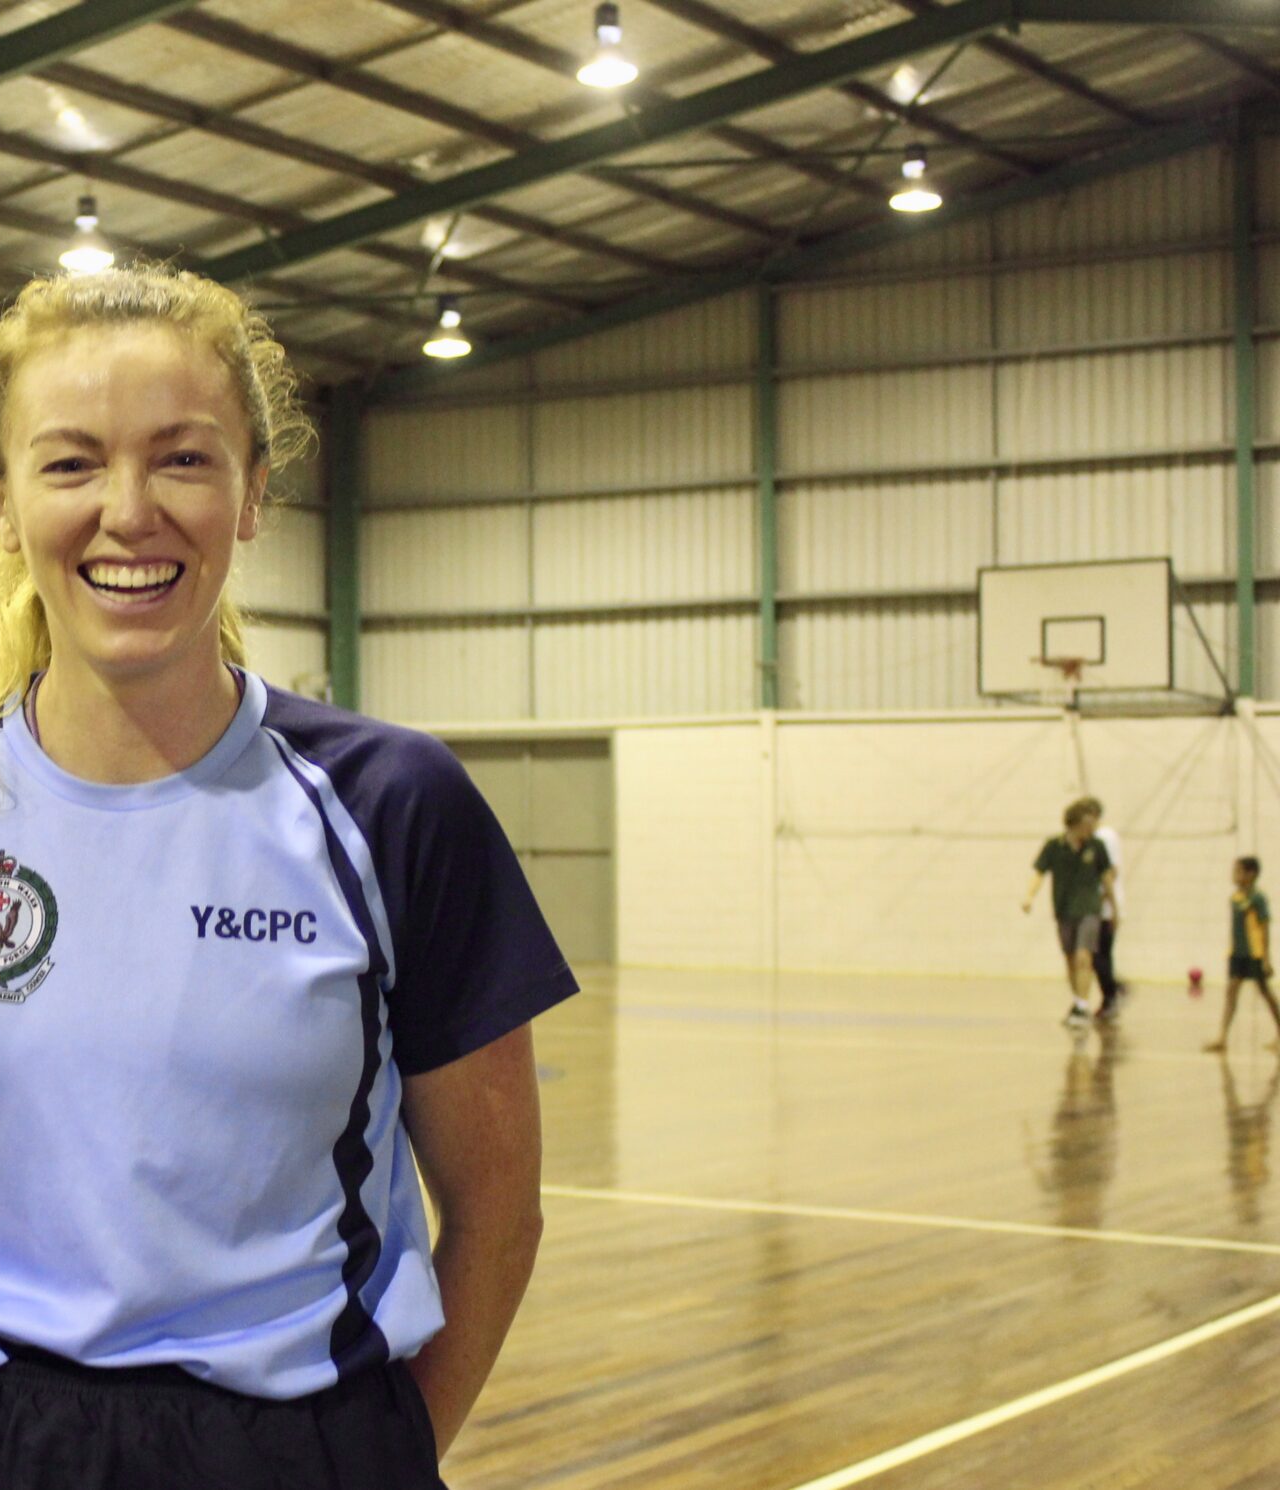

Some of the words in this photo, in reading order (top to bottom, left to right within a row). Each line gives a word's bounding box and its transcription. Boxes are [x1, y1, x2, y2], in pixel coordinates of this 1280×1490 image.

[18, 884, 38, 908] WALES
[190, 905, 317, 944] Y&CPC
[4, 945, 29, 963] FORCE
